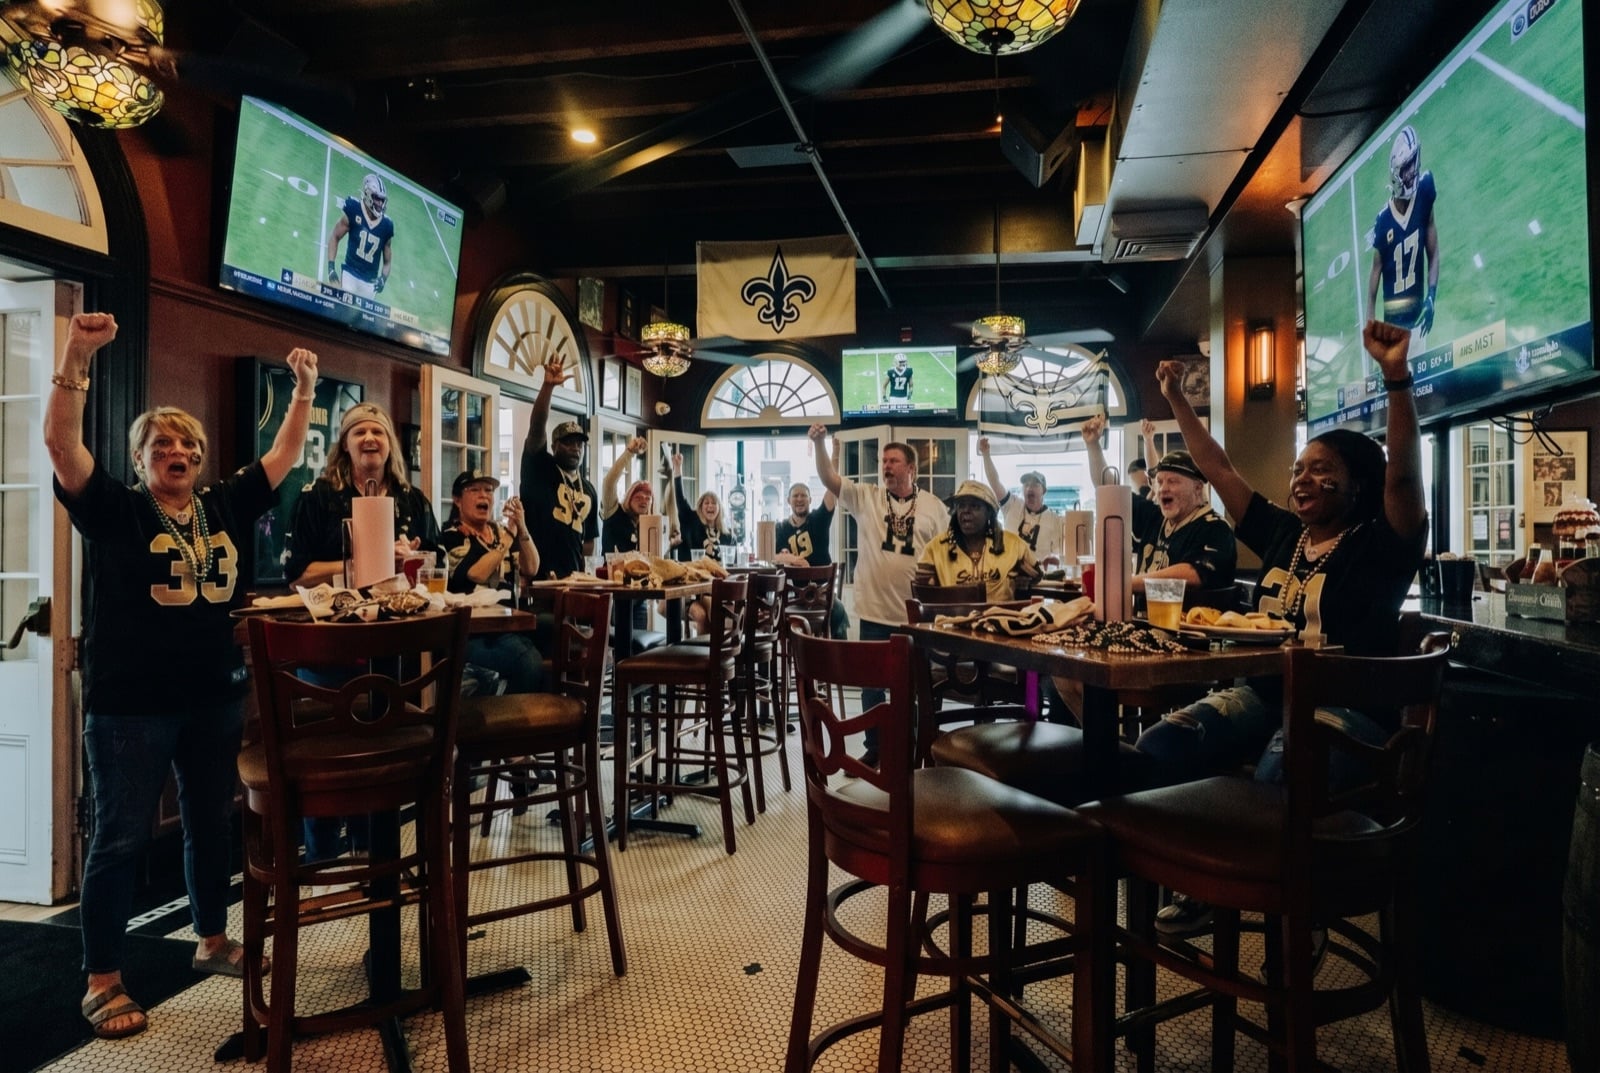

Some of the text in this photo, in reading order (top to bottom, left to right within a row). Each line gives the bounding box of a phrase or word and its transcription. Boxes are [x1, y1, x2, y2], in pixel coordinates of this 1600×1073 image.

[355, 230, 380, 264] 17
[1393, 228, 1420, 295] 17
[894, 376, 907, 390] 17
[149, 530, 239, 606] 33
[787, 531, 813, 558] 19
[1259, 566, 1327, 646] 21
